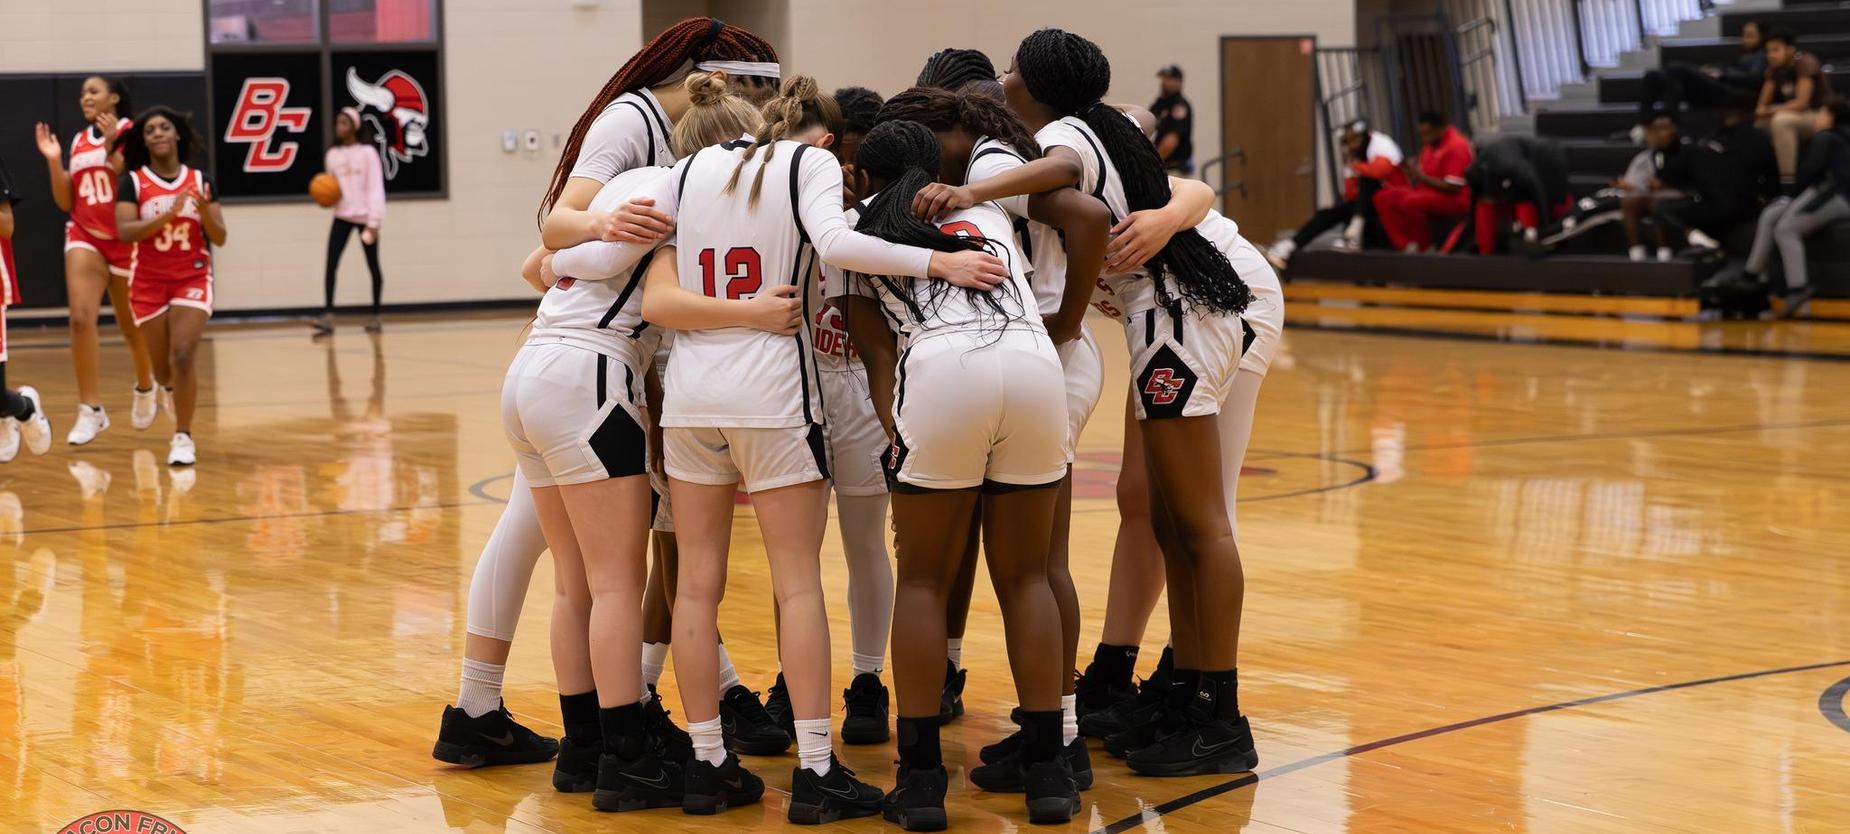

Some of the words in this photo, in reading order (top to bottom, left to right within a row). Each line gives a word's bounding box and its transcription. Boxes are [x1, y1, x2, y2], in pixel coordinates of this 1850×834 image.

[224, 77, 312, 173] BC
[79, 170, 113, 206] 40
[154, 222, 192, 252] 34
[698, 246, 763, 300] 12
[1144, 367, 1186, 405] BC
